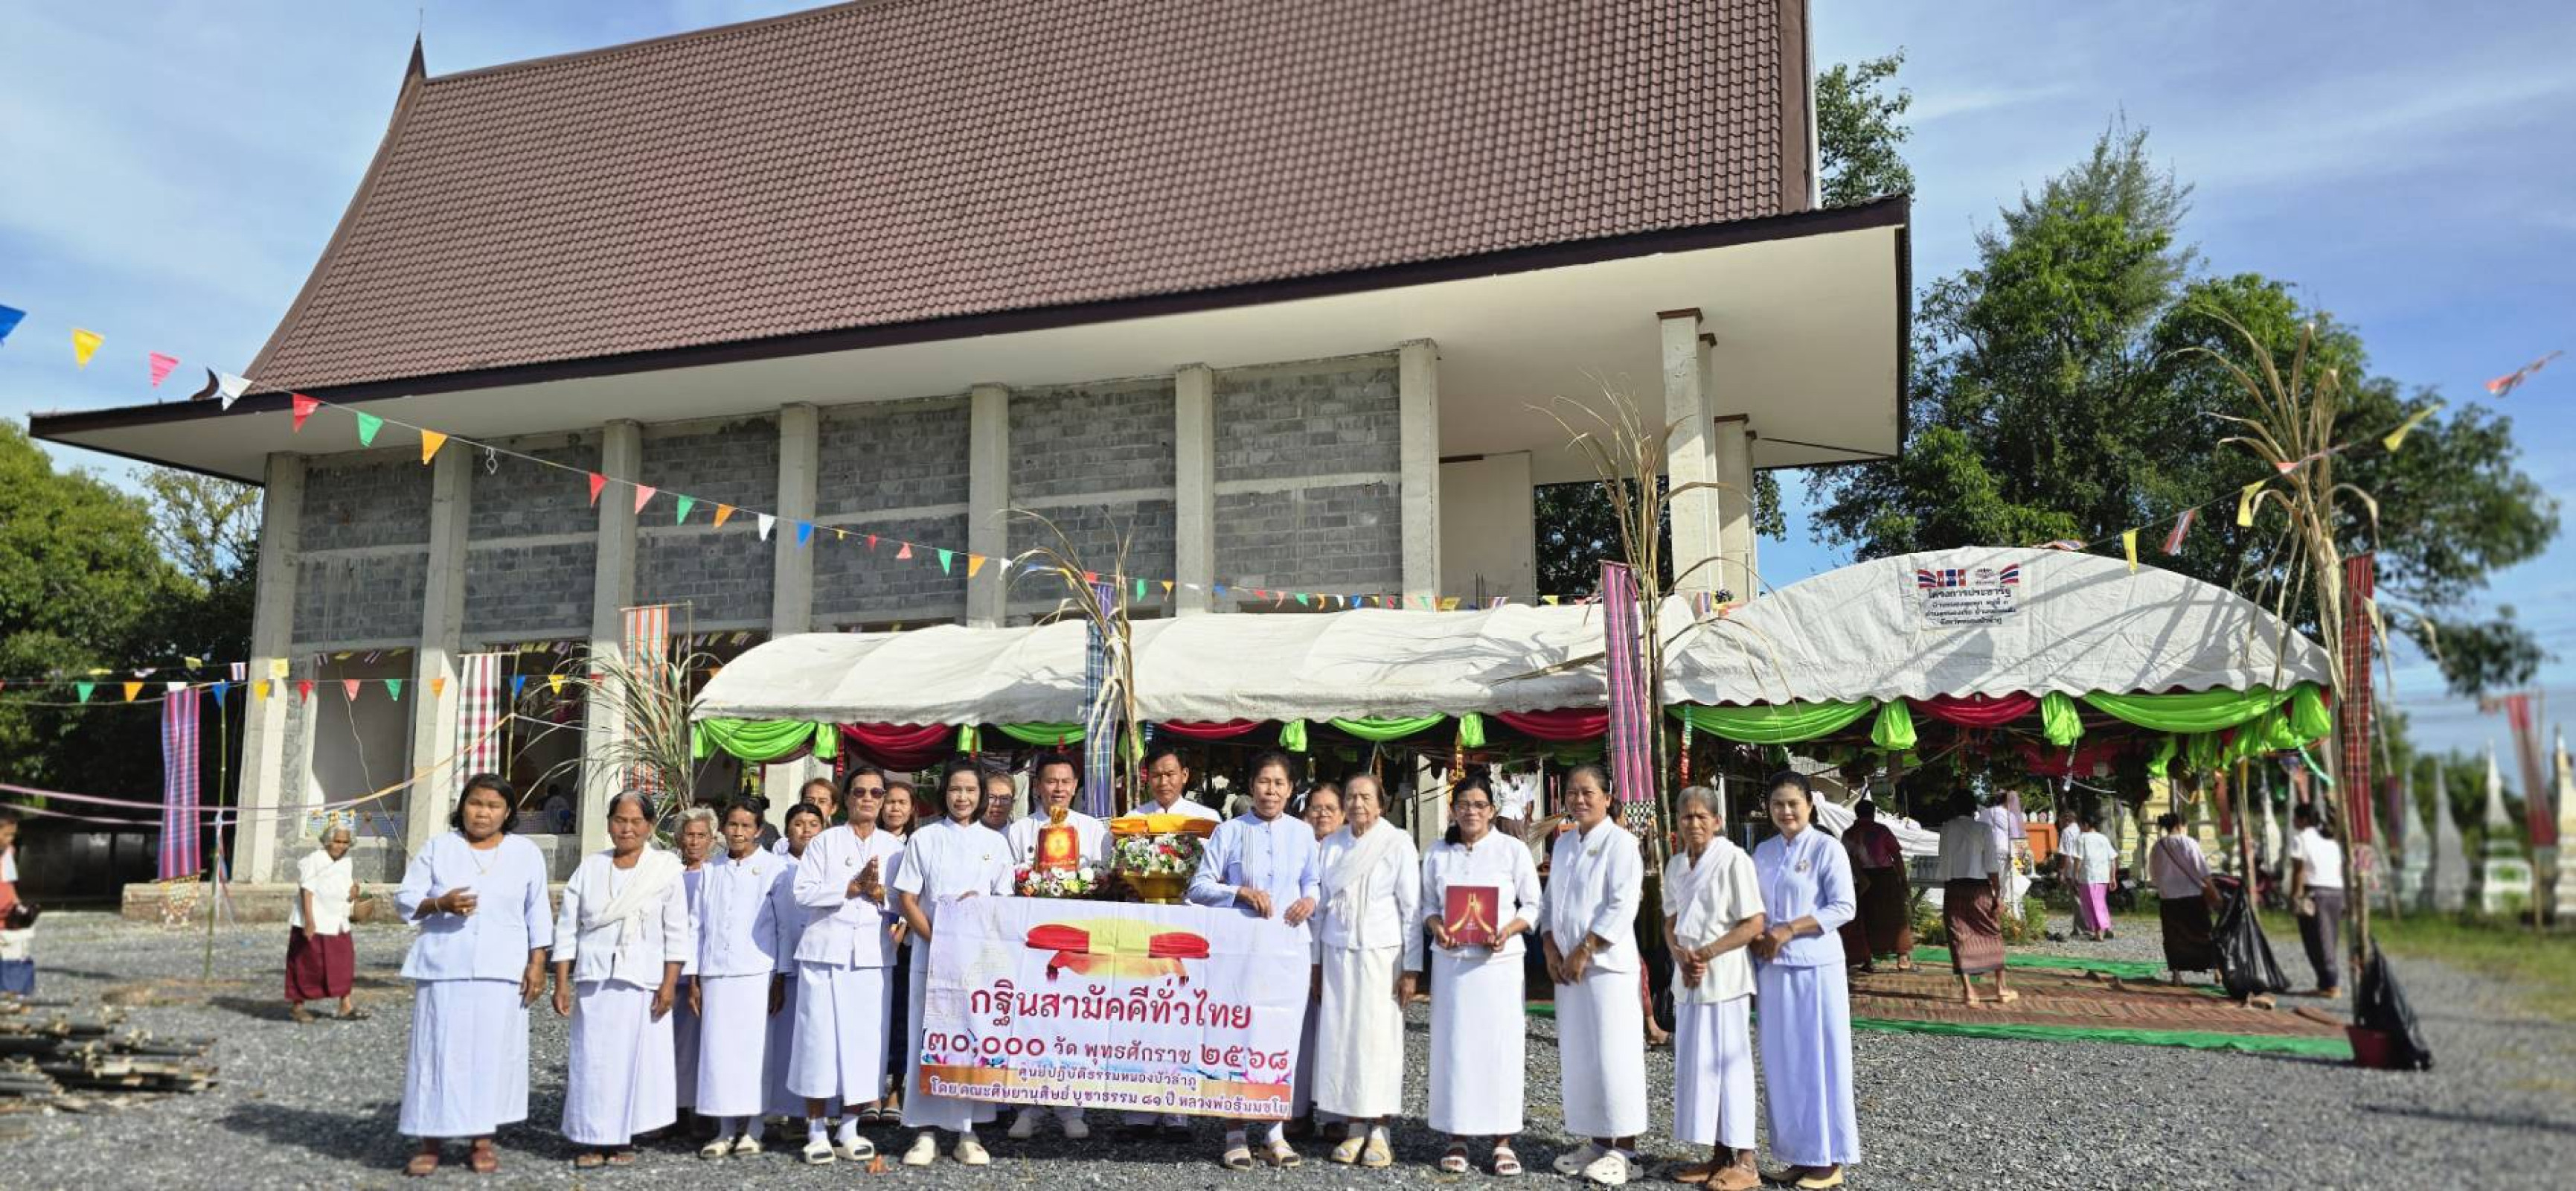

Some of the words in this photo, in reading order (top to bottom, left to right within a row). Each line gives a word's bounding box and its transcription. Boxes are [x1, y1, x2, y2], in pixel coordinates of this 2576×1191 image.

[970, 977, 1252, 1029] กฐินสามัคคีทั่วไทย
[928, 1032, 1045, 1058] ๓๐,๐๐๐
[1054, 1035, 1077, 1056] วัด
[1084, 1039, 1191, 1065] พุทธศักราช
[1200, 1043, 1289, 1070] ๒๕๖๘
[1073, 1090, 1138, 1107] บูชาธรรม
[1141, 1094, 1162, 1106] ๘๑
[1165, 1091, 1175, 1106] ปี
